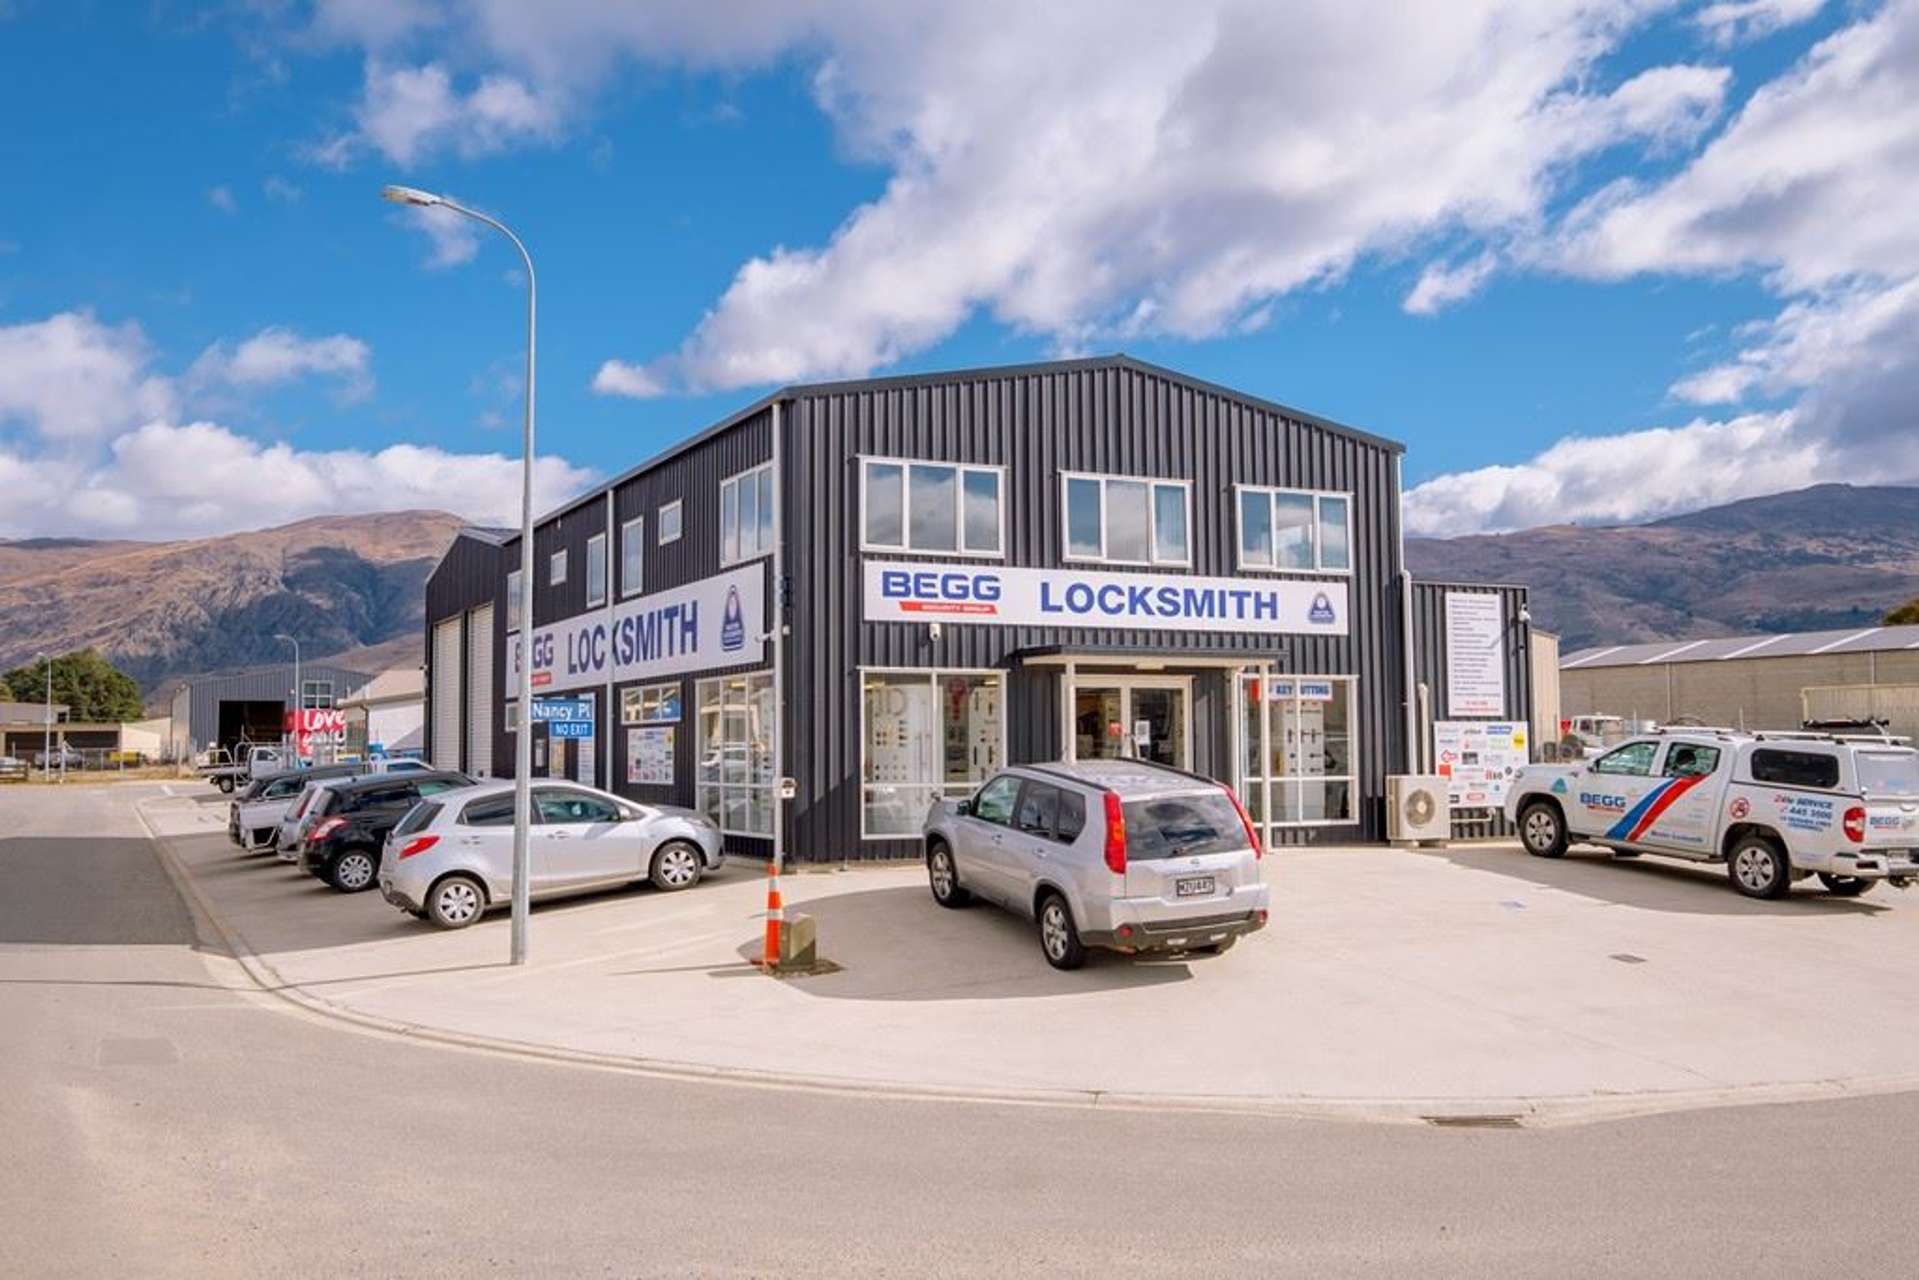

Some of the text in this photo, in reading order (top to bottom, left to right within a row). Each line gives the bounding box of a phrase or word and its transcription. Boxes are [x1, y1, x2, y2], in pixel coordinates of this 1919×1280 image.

[882, 571, 1001, 600] BEGG
[1041, 582, 1278, 619] LOCKSMITH
[515, 633, 554, 673] BGG
[1300, 685, 1329, 695] UTTING
[533, 703, 591, 720] Nancy Pl
[555, 724, 588, 735] NO EXIT
[1580, 792, 1626, 808] BEGG
[1796, 798, 1833, 809] SERVICE
[1870, 816, 1899, 826] BEGG
